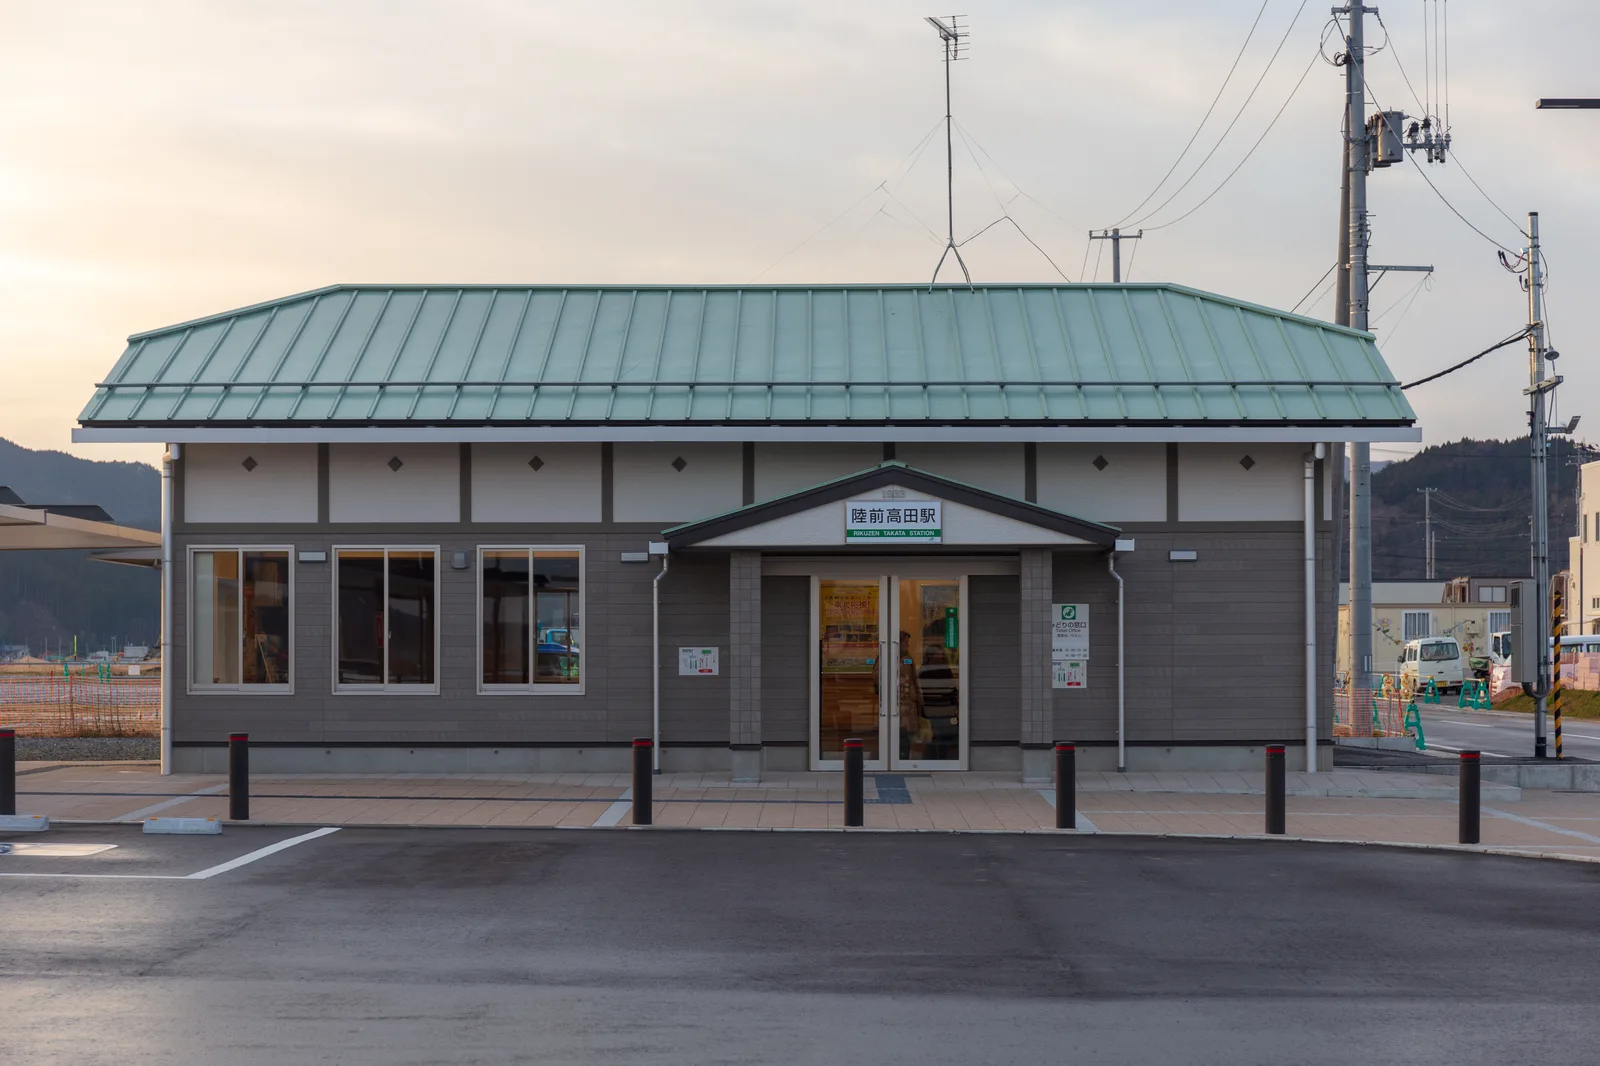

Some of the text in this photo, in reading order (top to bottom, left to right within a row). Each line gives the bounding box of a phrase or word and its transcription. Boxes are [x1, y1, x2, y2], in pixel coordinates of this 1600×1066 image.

[882, 489, 906, 499] 1933
[851, 508, 936, 524] 陸前高田駅
